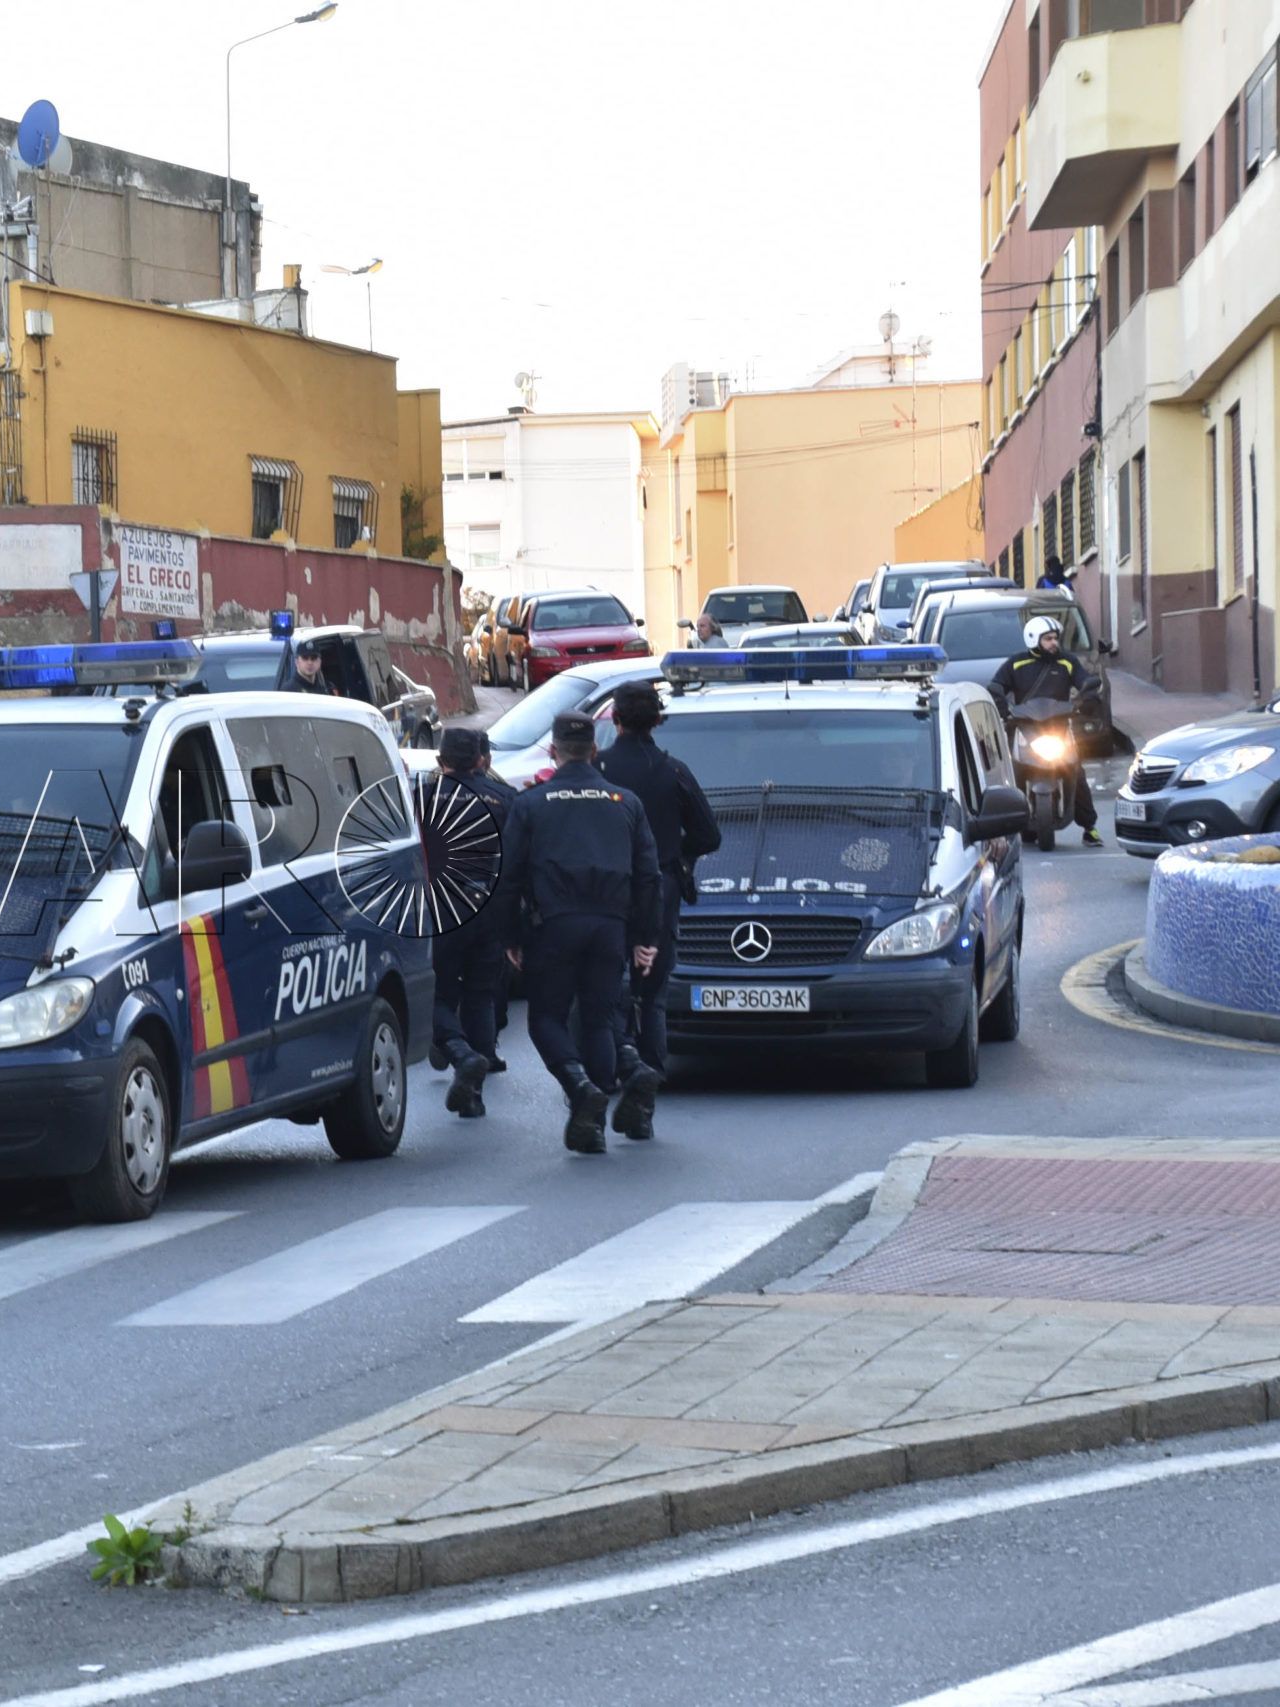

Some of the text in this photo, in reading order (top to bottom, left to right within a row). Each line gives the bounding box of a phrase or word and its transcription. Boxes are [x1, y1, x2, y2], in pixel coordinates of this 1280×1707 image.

[121, 527, 187, 550] AZULEJOS Y
[128, 545, 184, 567] PAVIMENTOS
[127, 563, 191, 590] EL GRECO
[546, 789, 611, 801] POLICIA
[274, 939, 367, 1021] POLICIA
